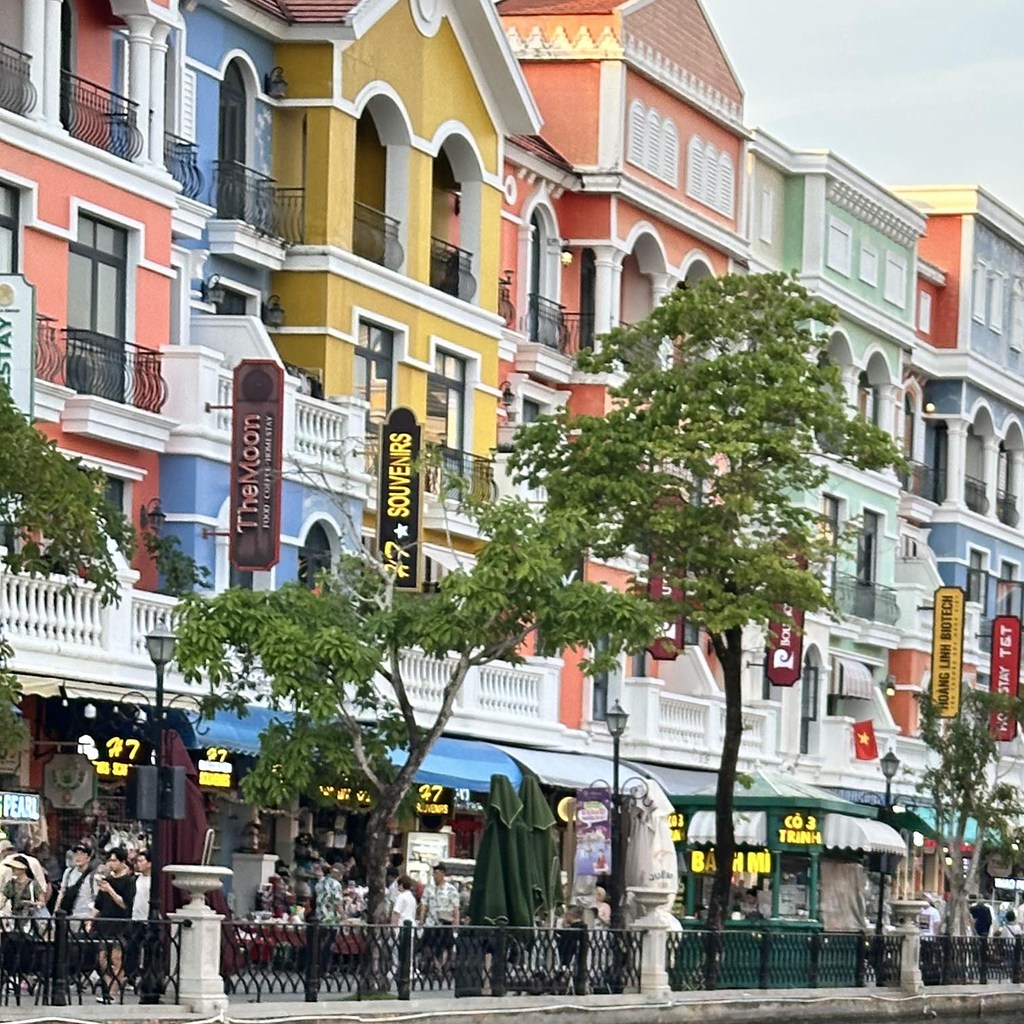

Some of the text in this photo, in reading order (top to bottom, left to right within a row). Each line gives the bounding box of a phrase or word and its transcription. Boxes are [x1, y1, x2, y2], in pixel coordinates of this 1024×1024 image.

[388, 433, 412, 517] SOUVENIRS
[941, 595, 953, 640] BIOTECH
[999, 625, 1012, 657] T&T
[940, 644, 951, 669] LINH
[3, 794, 39, 820] PEARL
[806, 816, 817, 830] 3
[692, 848, 744, 873] BÁH
